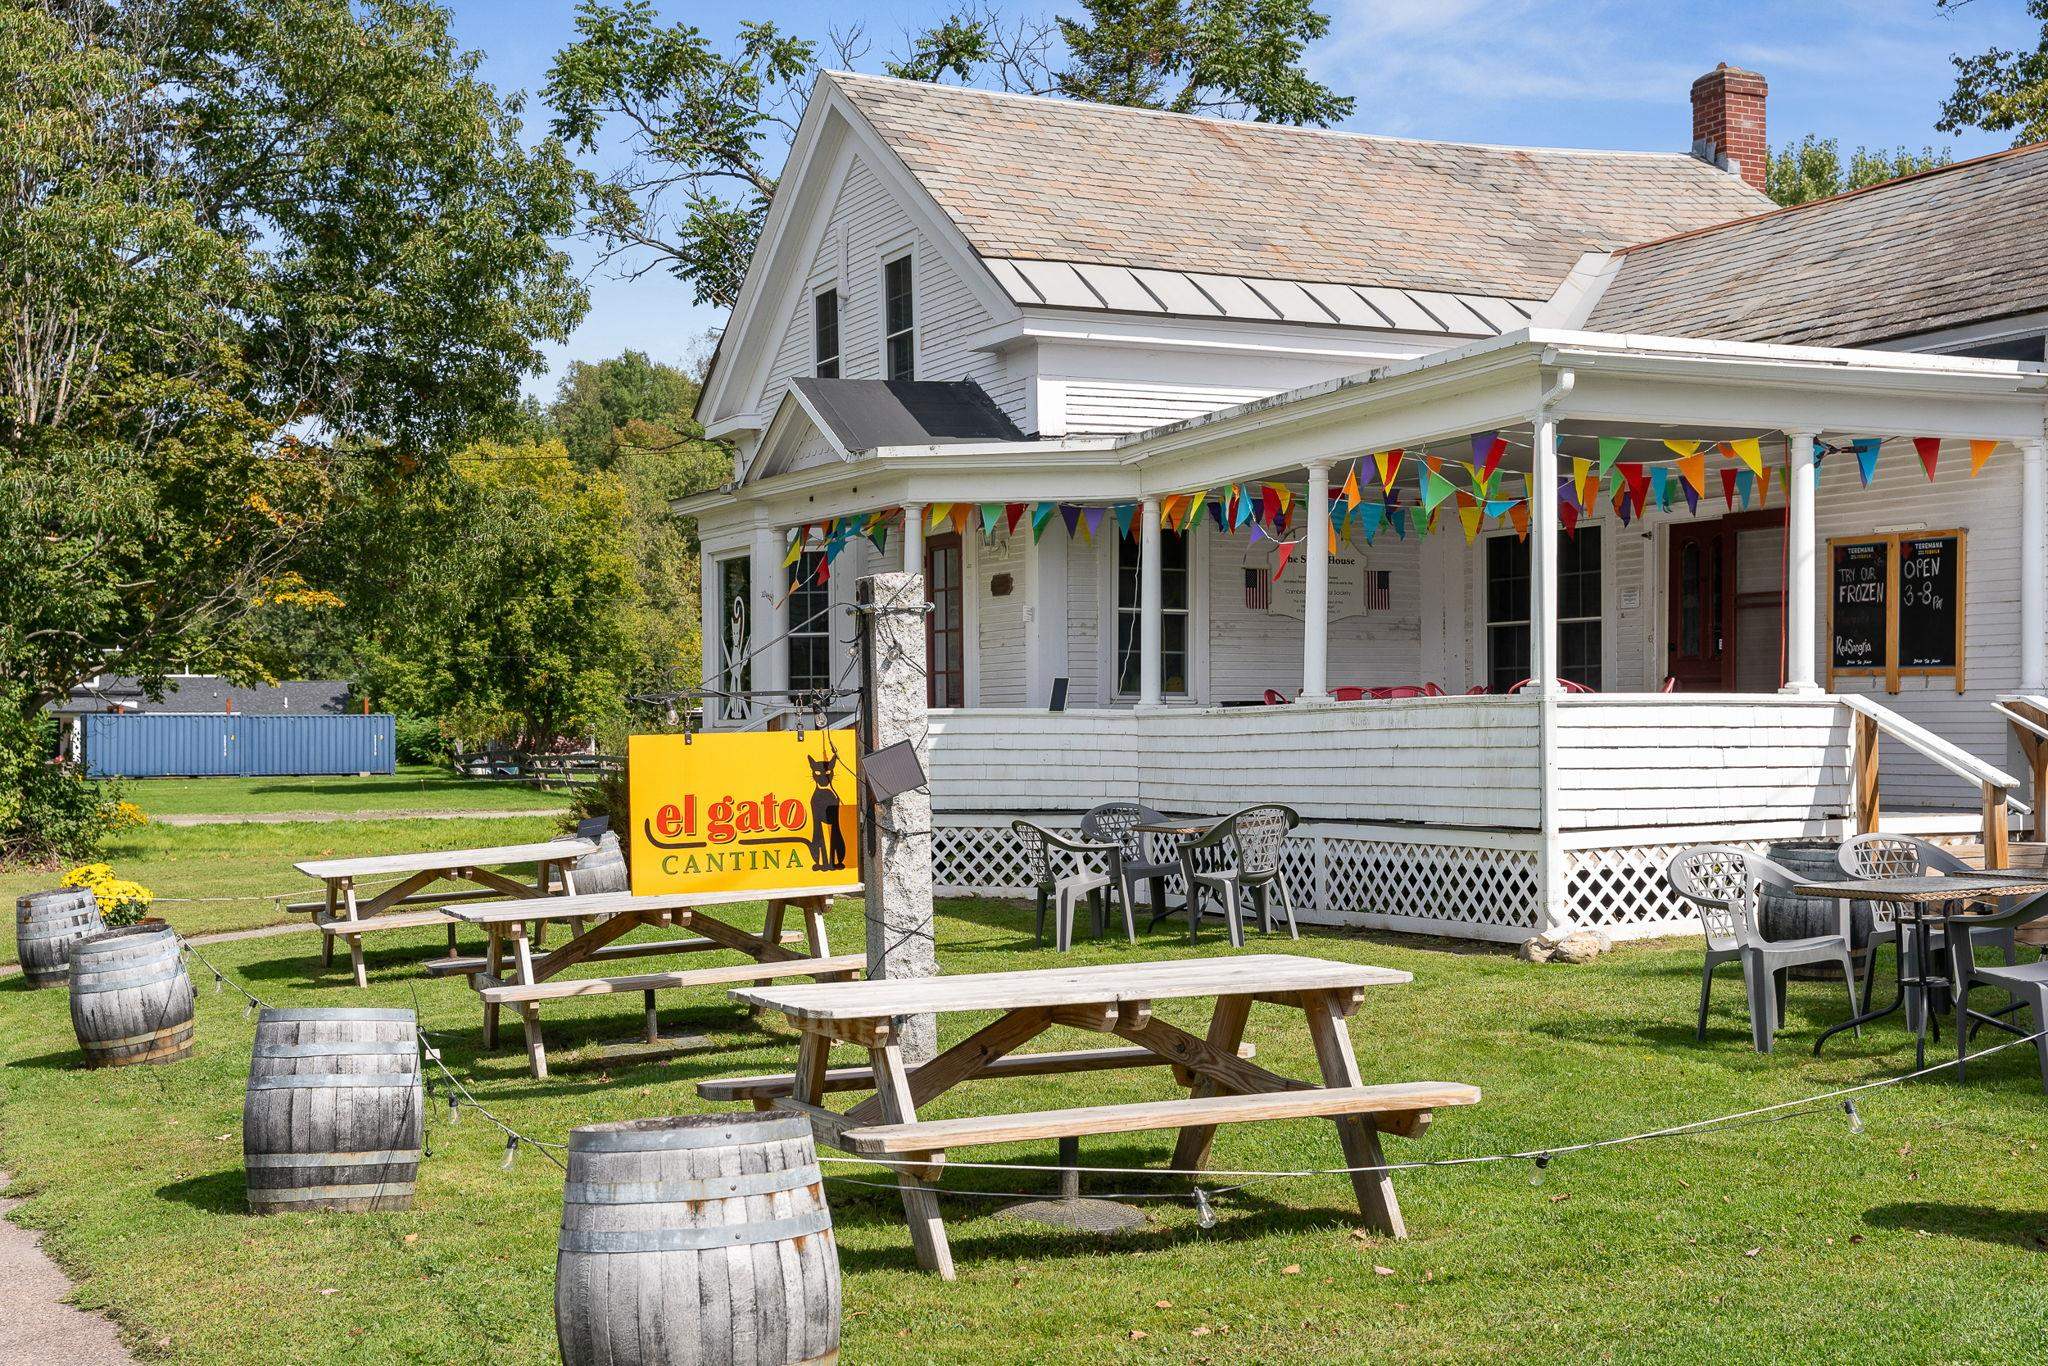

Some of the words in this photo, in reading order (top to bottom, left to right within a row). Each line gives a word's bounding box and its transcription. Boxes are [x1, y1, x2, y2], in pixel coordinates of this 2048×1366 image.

[1328, 556, 1355, 565] House
[1904, 557, 1940, 579] OPEN
[1837, 568, 1856, 583] TRY
[1839, 582, 1884, 604] FROZEN
[656, 794, 697, 838] el
[706, 792, 807, 844] gato
[661, 848, 804, 876] CANTINA
